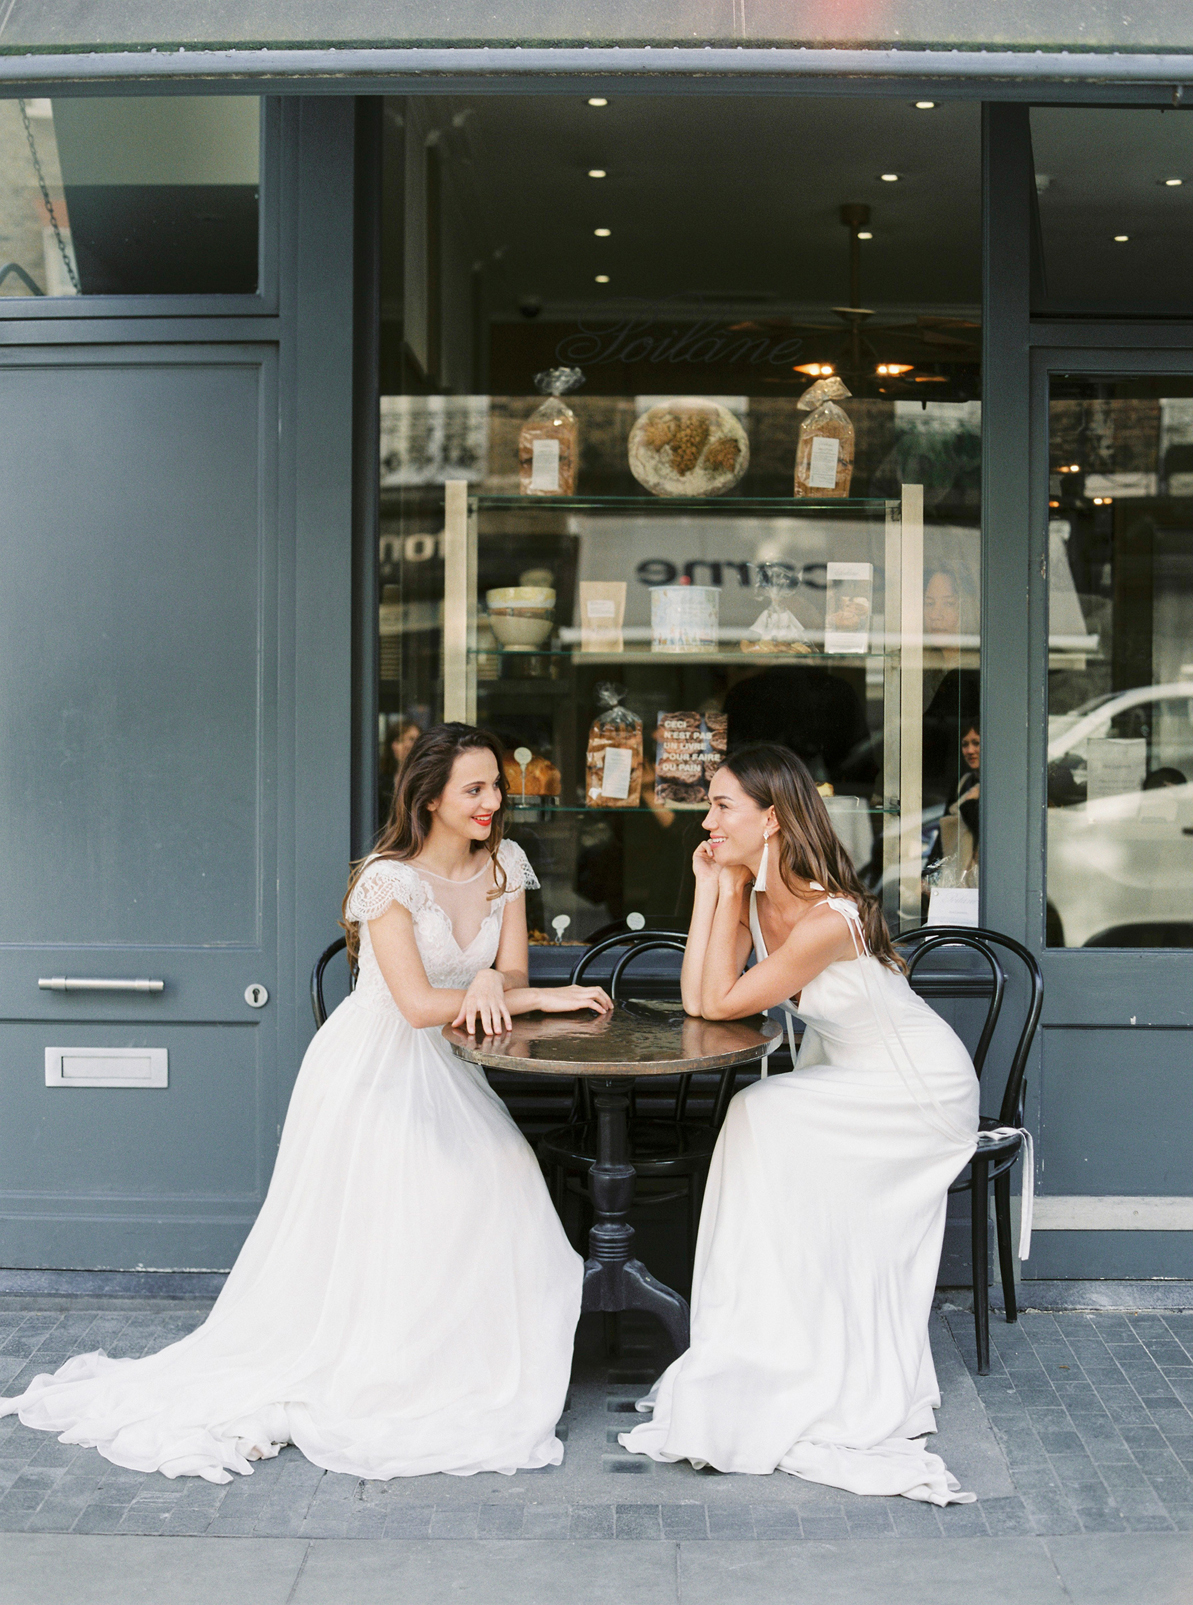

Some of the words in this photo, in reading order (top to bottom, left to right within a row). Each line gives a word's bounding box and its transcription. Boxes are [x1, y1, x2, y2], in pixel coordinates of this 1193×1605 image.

[664, 720, 687, 729] CECI
[664, 731, 691, 739] N'EST
[693, 732, 713, 740] PAS
[663, 742, 678, 750] UN
[681, 742, 707, 750] LIVRE
[663, 753, 690, 761] POUR
[692, 753, 721, 761] FAIRE
[678, 763, 701, 772] PAIN
